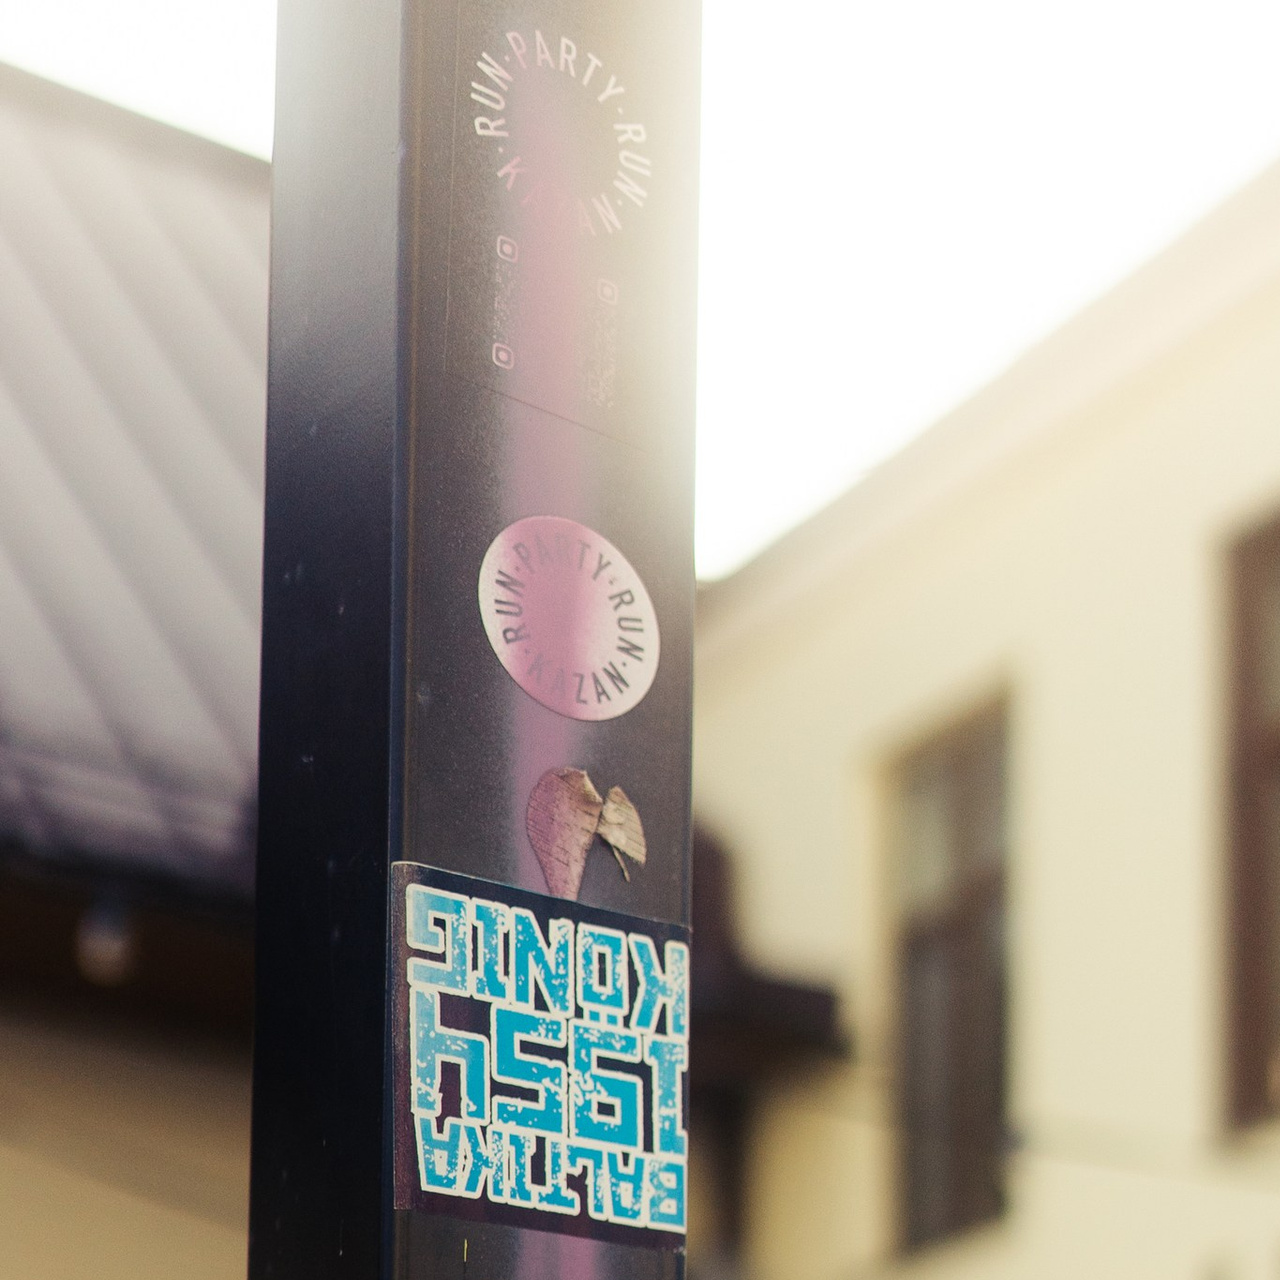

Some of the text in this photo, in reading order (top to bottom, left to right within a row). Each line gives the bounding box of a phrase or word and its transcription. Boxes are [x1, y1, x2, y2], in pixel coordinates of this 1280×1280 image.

[470, 51, 513, 137] RUN
[505, 29, 625, 103] PARTY
[613, 122, 652, 207] RUN
[494, 532, 644, 705] RUN PARTY RUN KAZAN
[406, 884, 690, 1040] KÖNIG
[410, 987, 690, 1156] 1954
[414, 1113, 688, 1234] BALTIKA
